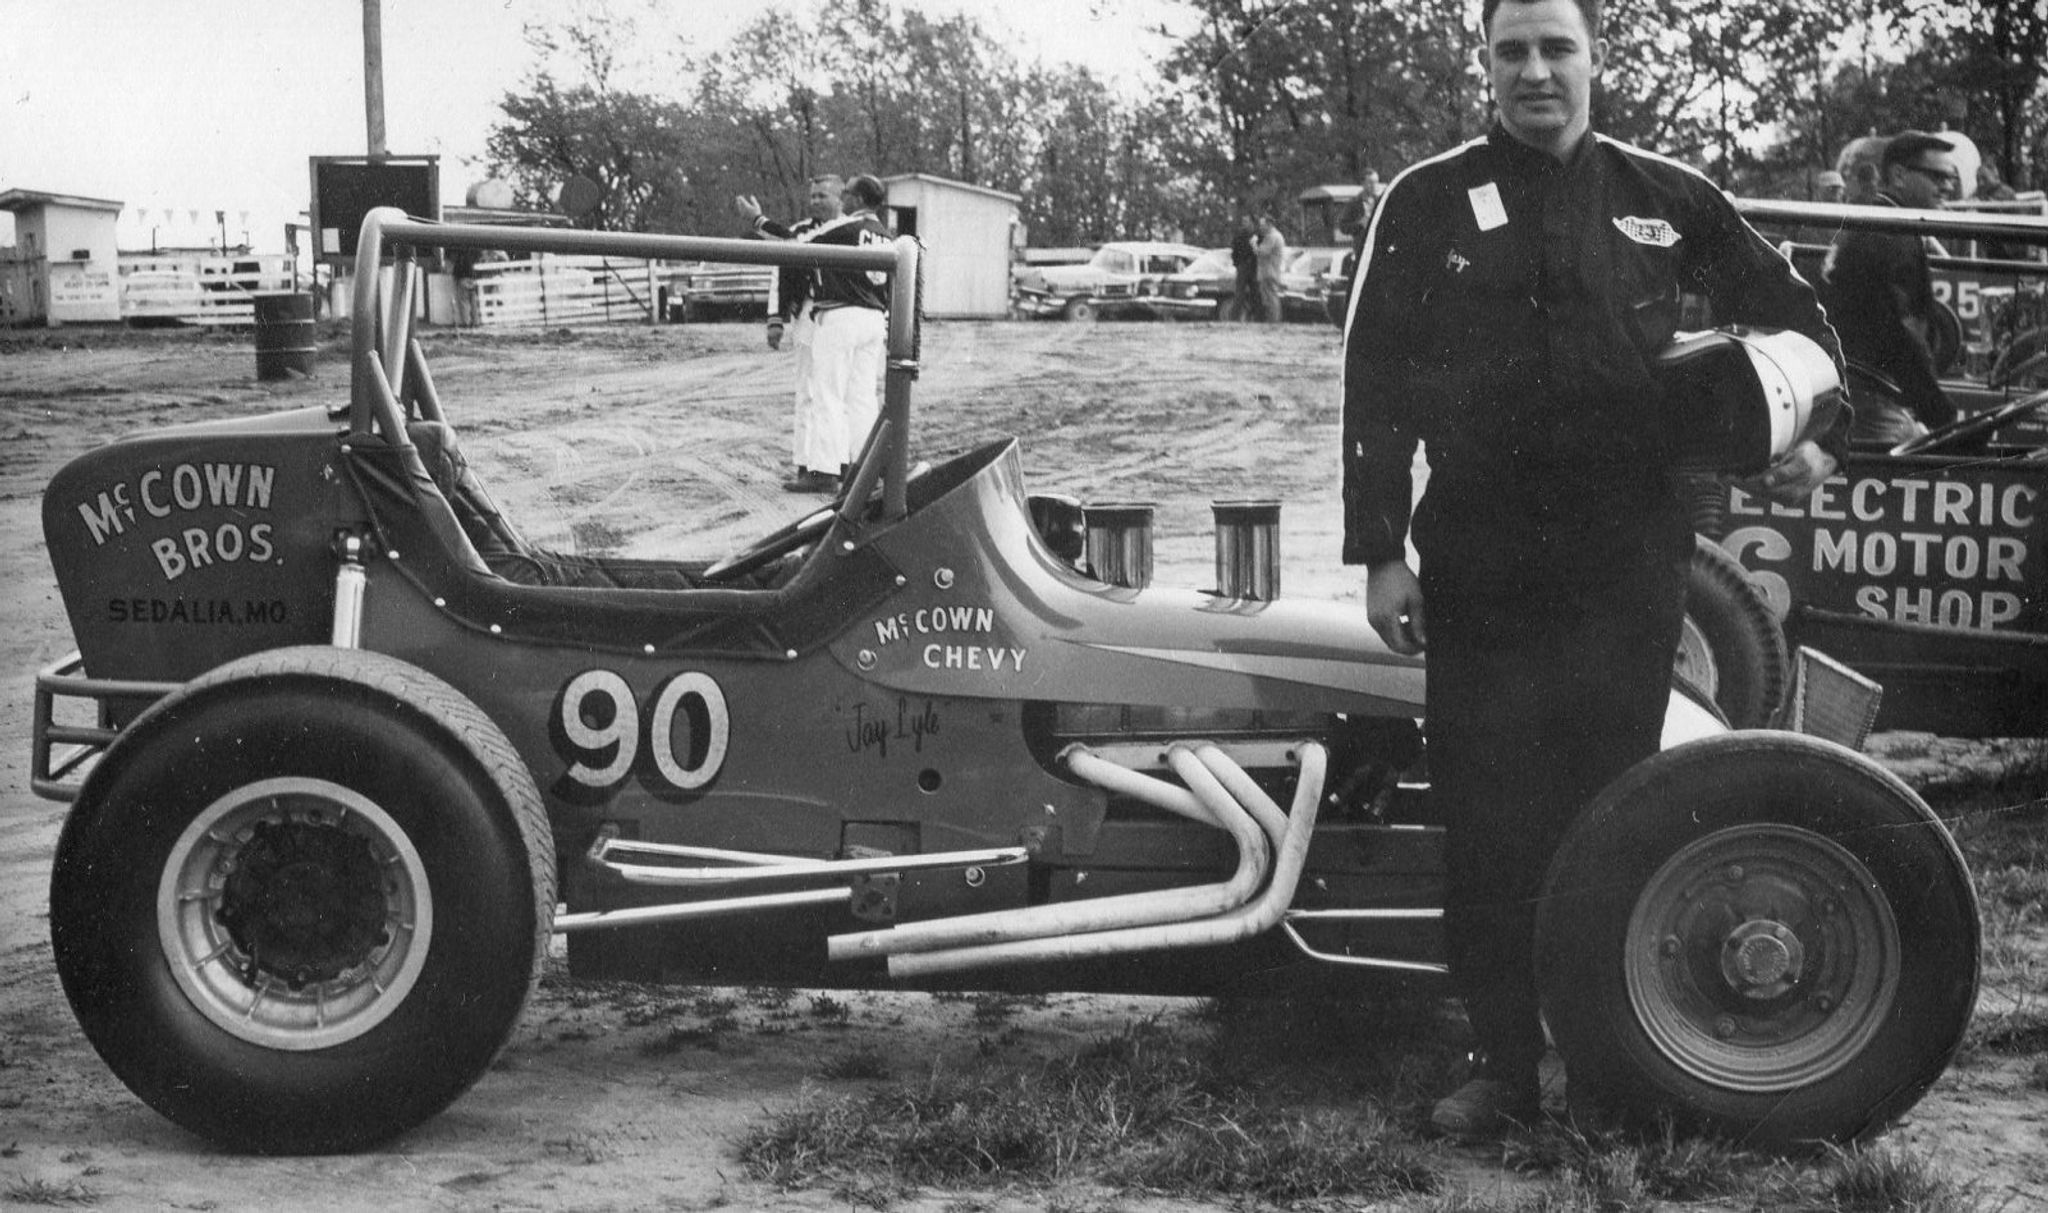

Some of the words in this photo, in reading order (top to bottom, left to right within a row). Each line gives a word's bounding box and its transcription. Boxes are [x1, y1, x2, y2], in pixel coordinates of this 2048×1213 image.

[151, 523, 283, 580] BROS.
[1720, 526, 1792, 623] 6
[1812, 528, 2027, 582] MOTOR
[1855, 585, 2022, 631] SHOP
[923, 643, 1027, 672] CHEVY
[562, 669, 730, 789] 90
